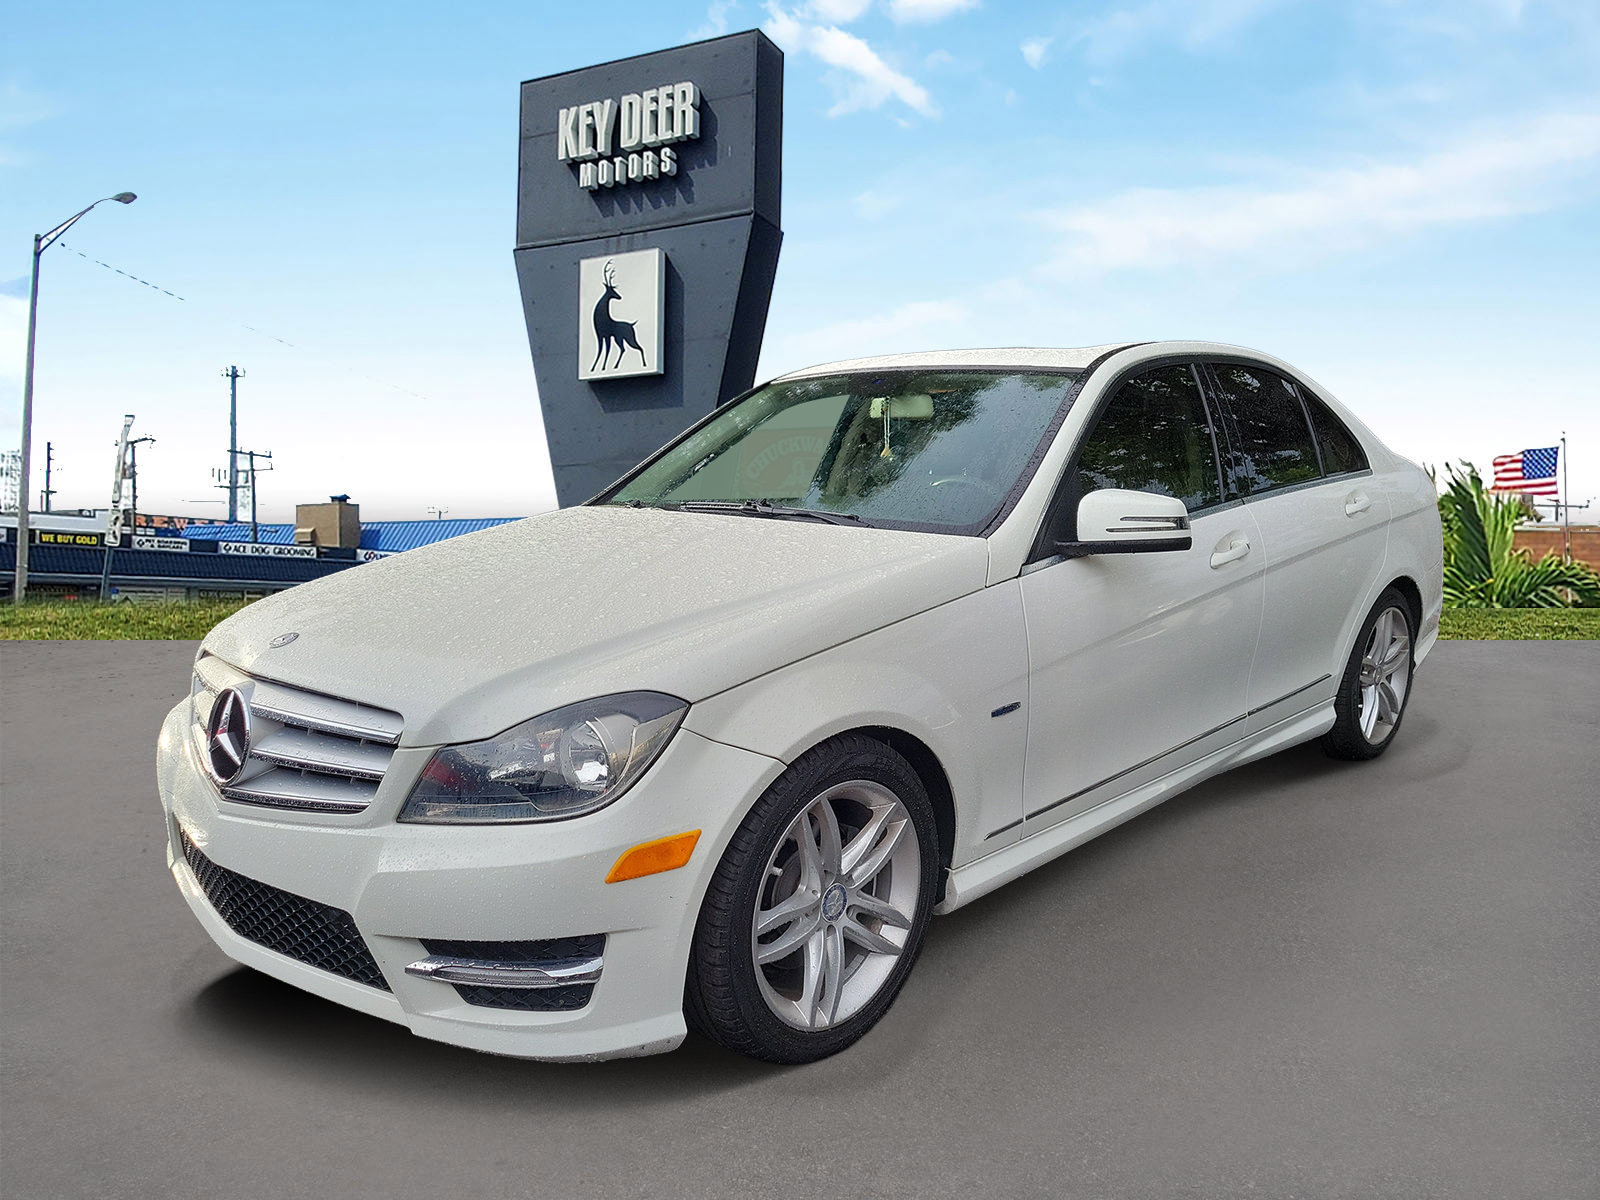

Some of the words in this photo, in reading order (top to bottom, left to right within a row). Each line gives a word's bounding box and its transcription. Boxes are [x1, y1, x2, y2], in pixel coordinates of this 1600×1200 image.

[557, 98, 617, 163] KEY
[620, 80, 700, 151] DEER
[578, 147, 677, 190] MOTORS
[41, 533, 56, 543] WE
[57, 534, 76, 545] BUY
[77, 536, 98, 546] GOLD
[233, 544, 247, 554] ACE
[251, 545, 270, 555] DOG
[273, 546, 315, 557] GROOMING
